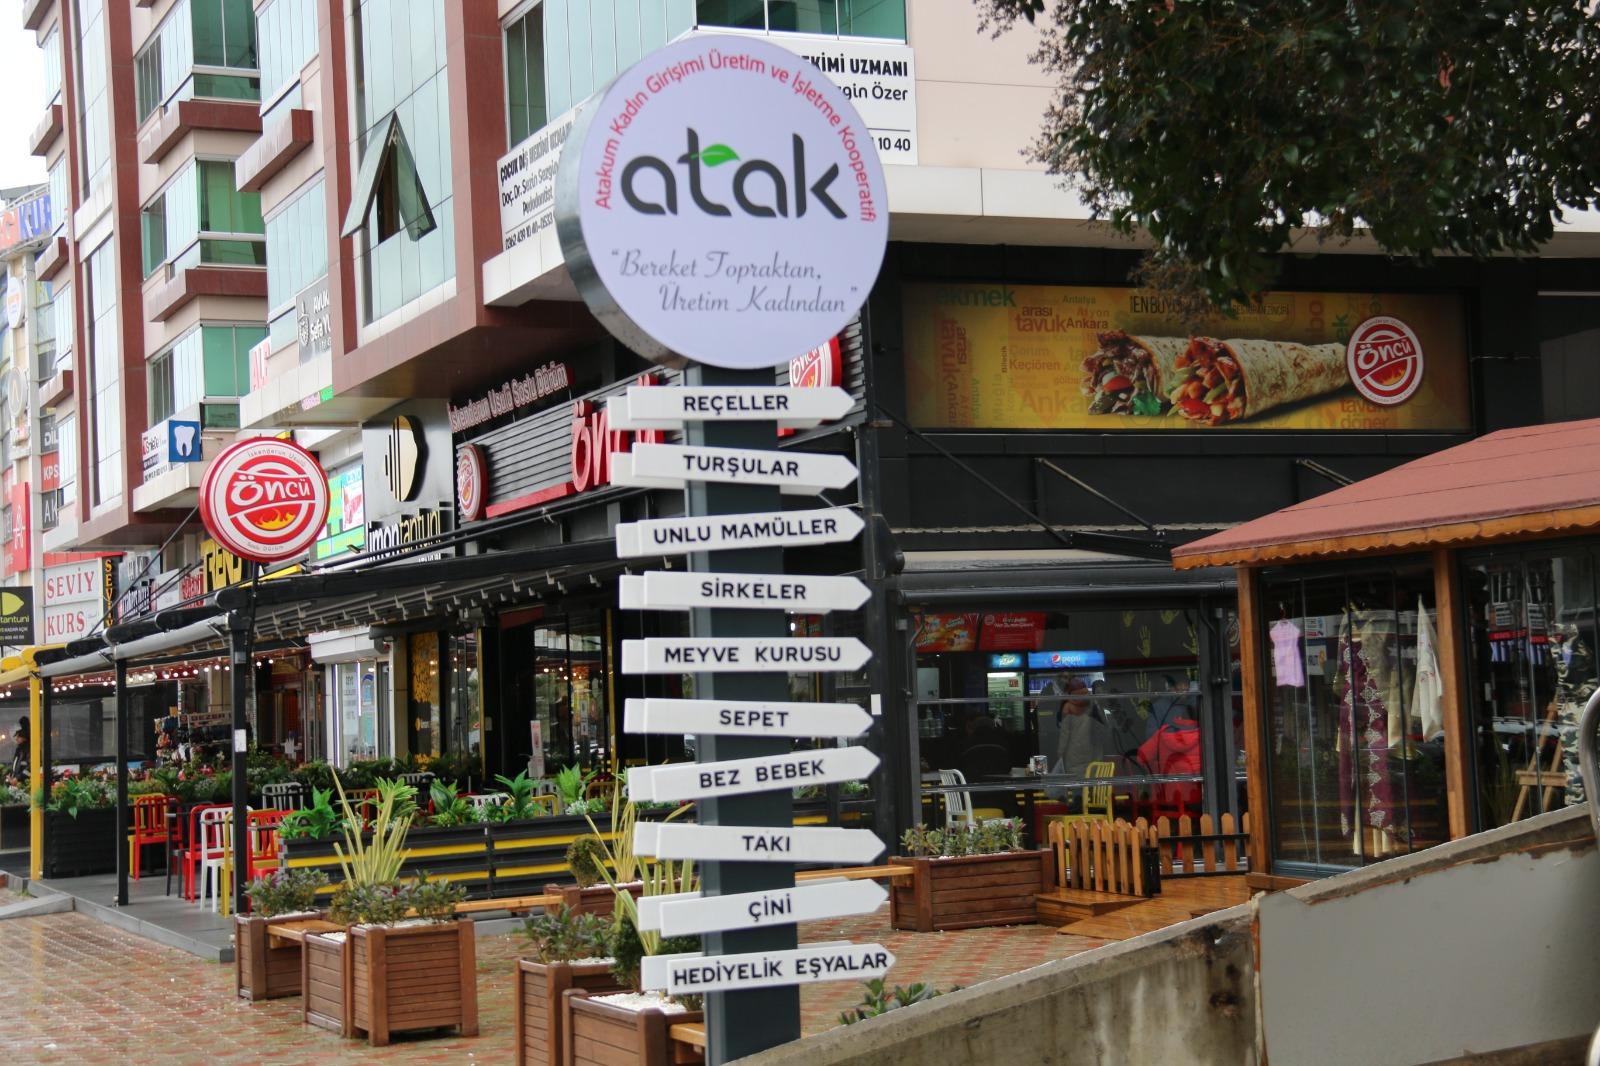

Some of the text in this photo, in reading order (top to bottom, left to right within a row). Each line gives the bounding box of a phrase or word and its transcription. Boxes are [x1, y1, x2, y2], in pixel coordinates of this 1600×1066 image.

[802, 52, 908, 76] KİMİ UZMANI
[872, 81, 908, 100] Özer
[595, 48, 877, 222] Atakum Kadın Girişimi Üretim ve İşletme Kooperatifi
[878, 137, 911, 151] 10 40
[620, 127, 848, 220] atak
[659, 281, 730, 311] Üretim
[1022, 306, 1053, 317] arası
[1015, 314, 1067, 333] tavuk
[1066, 318, 1108, 330] Ankara
[683, 395, 788, 416] REÇELLER
[683, 455, 799, 478] TURŞULAR
[654, 517, 837, 544] UNLU MAMÜLLER
[701, 578, 806, 600] SİRKELER
[47, 611, 85, 636] KURS
[664, 646, 841, 663] MEYVE KURUSU
[719, 710, 789, 727] SEPET
[700, 759, 825, 788] BEZ BEBEK
[742, 835, 790, 852] TAKI
[748, 893, 792, 922] ÇİNİ
[673, 952, 888, 986] HEDİYELİK EŞYALAR
